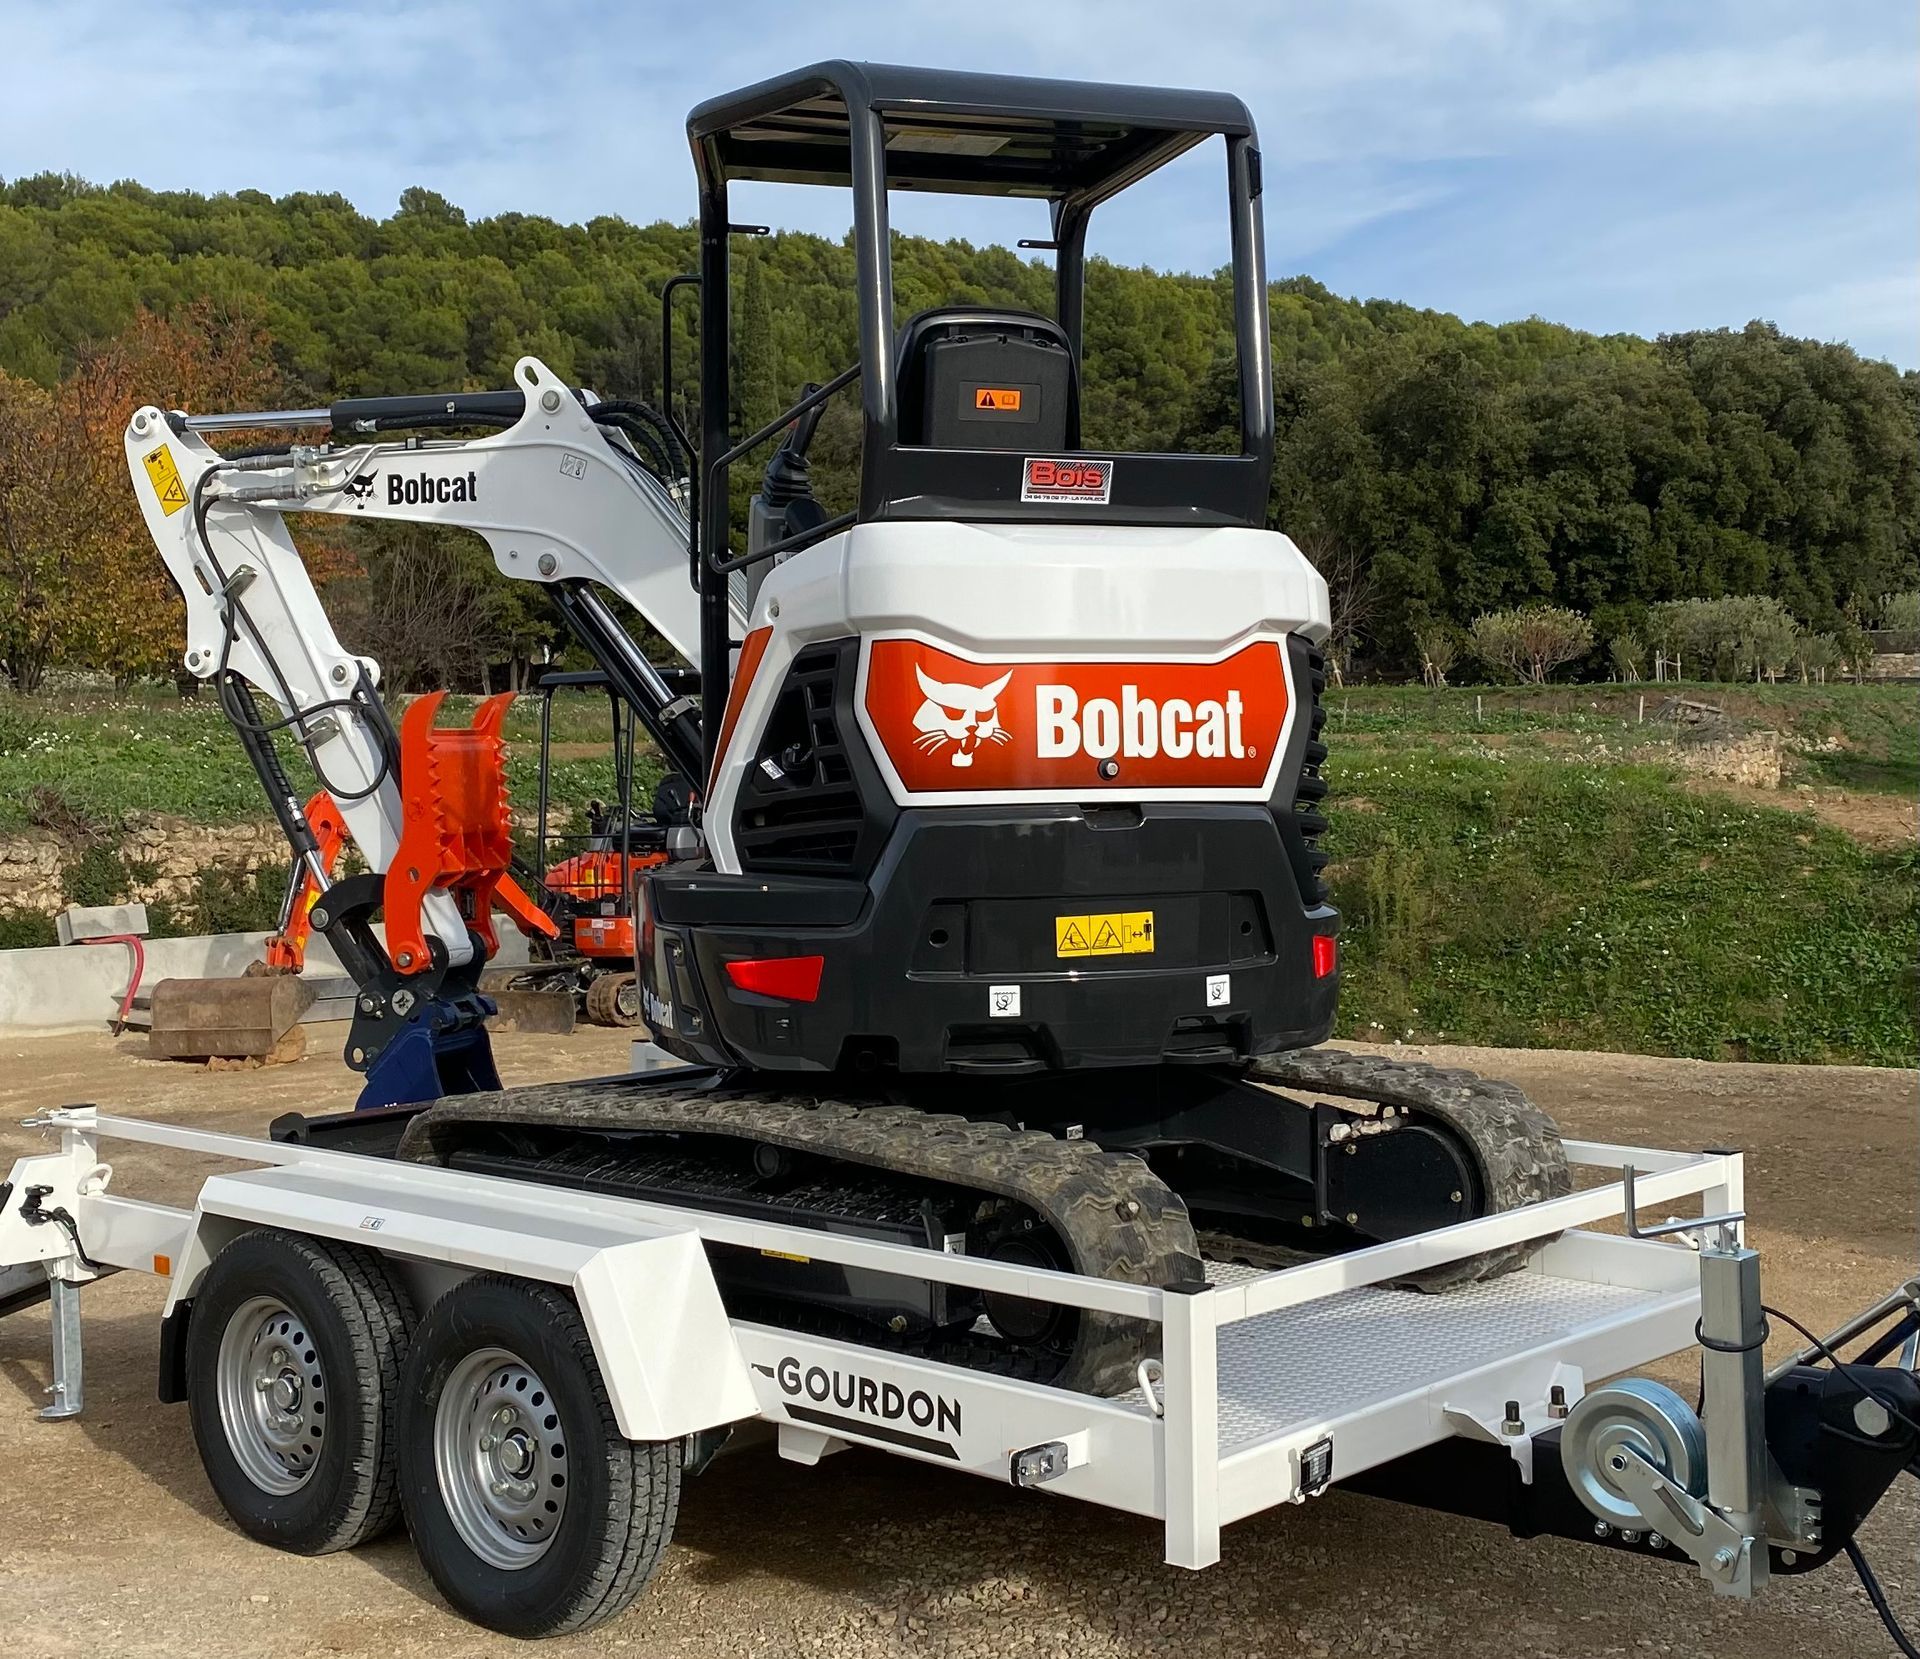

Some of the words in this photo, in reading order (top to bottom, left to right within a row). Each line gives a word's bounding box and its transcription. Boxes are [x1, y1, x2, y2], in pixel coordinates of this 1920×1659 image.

[387, 471, 477, 505] Bobcat
[650, 993, 674, 1029] Bobcat
[777, 1357, 961, 1437] GOURDON
